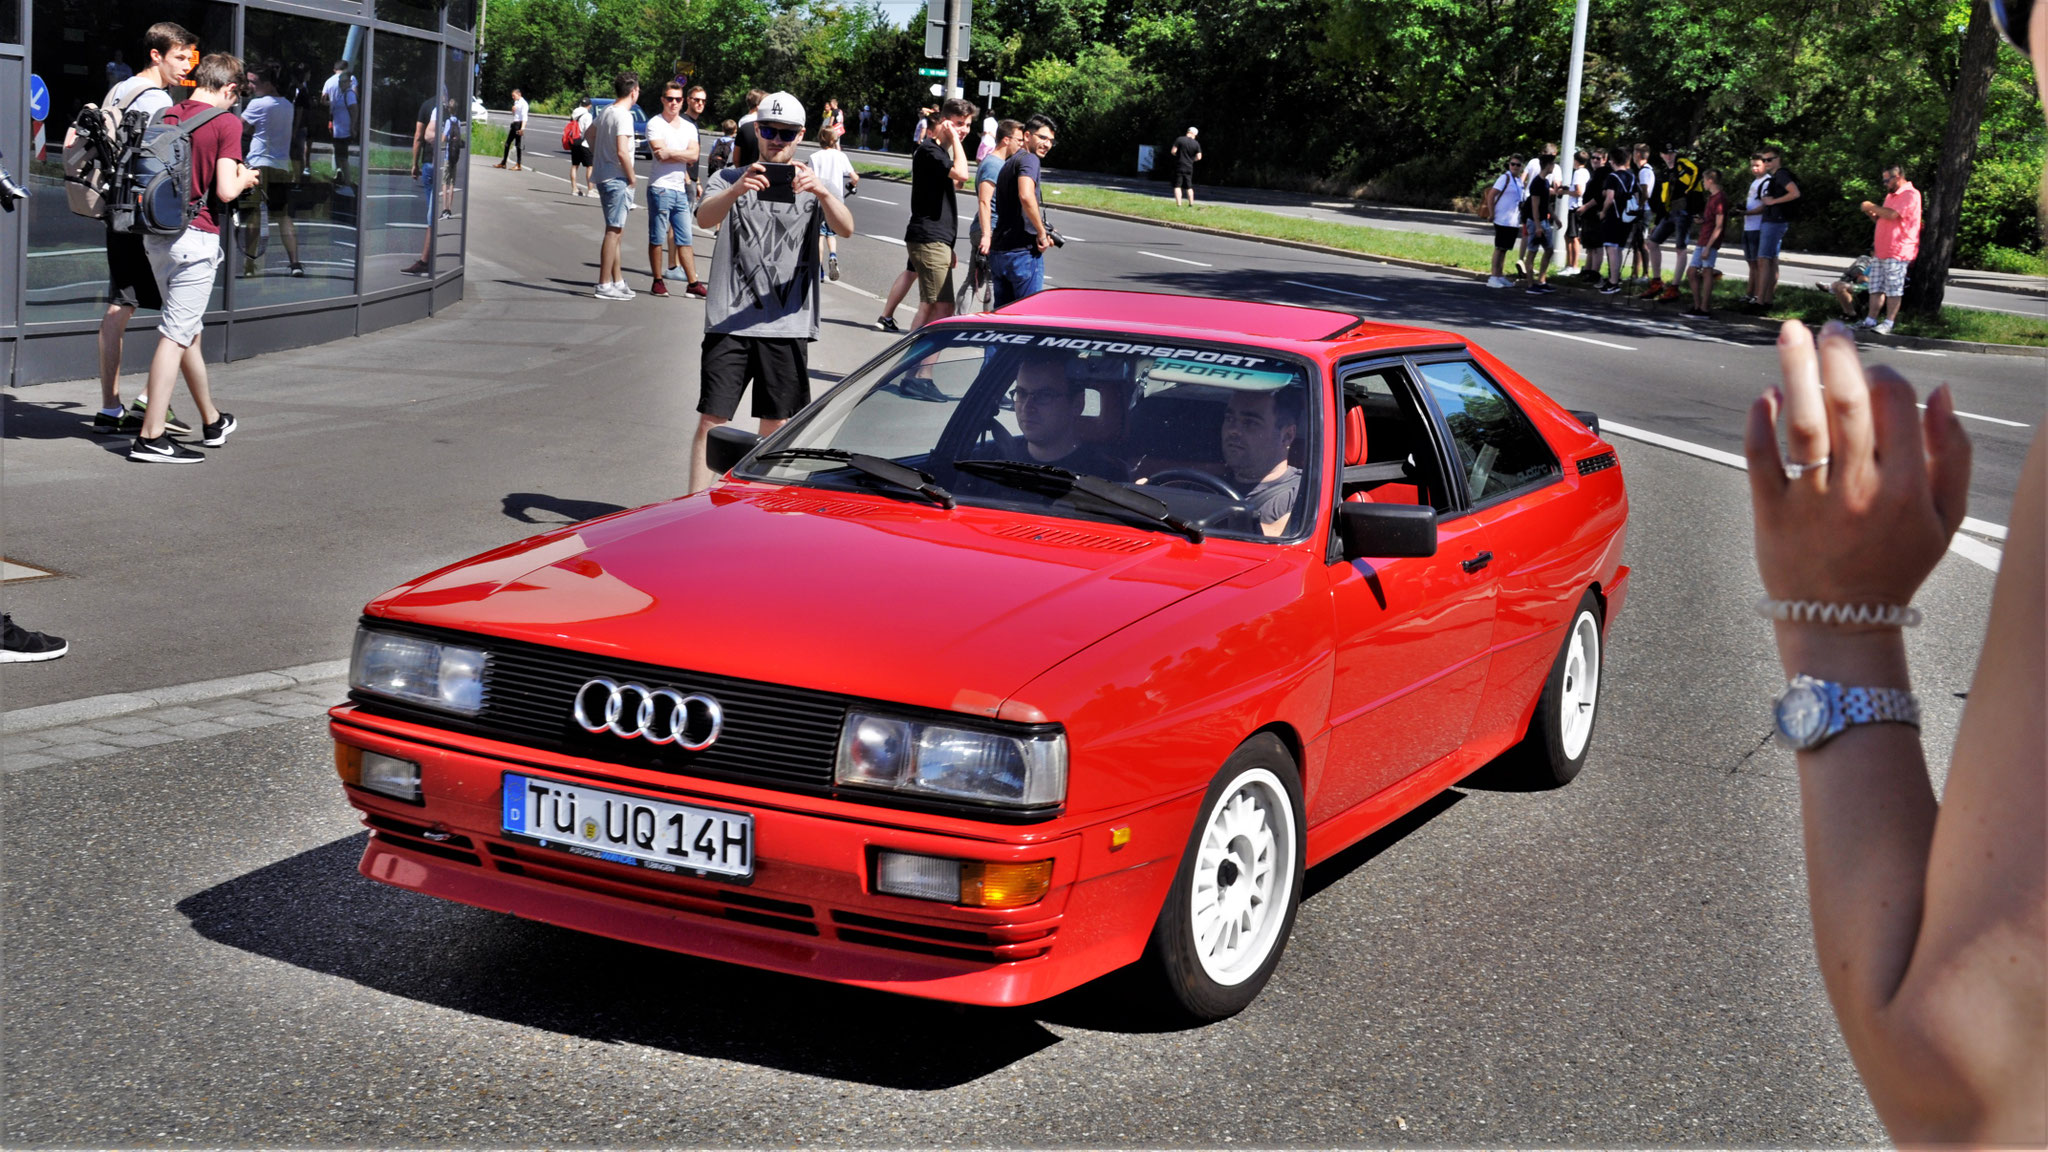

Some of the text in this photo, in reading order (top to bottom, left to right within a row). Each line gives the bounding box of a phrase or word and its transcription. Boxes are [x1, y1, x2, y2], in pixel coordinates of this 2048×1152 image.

[771, 99, 783, 115] LA
[953, 330, 1266, 368] LÜKE MOTORSPORT
[510, 808, 520, 821] D
[528, 784, 576, 835] TÜ
